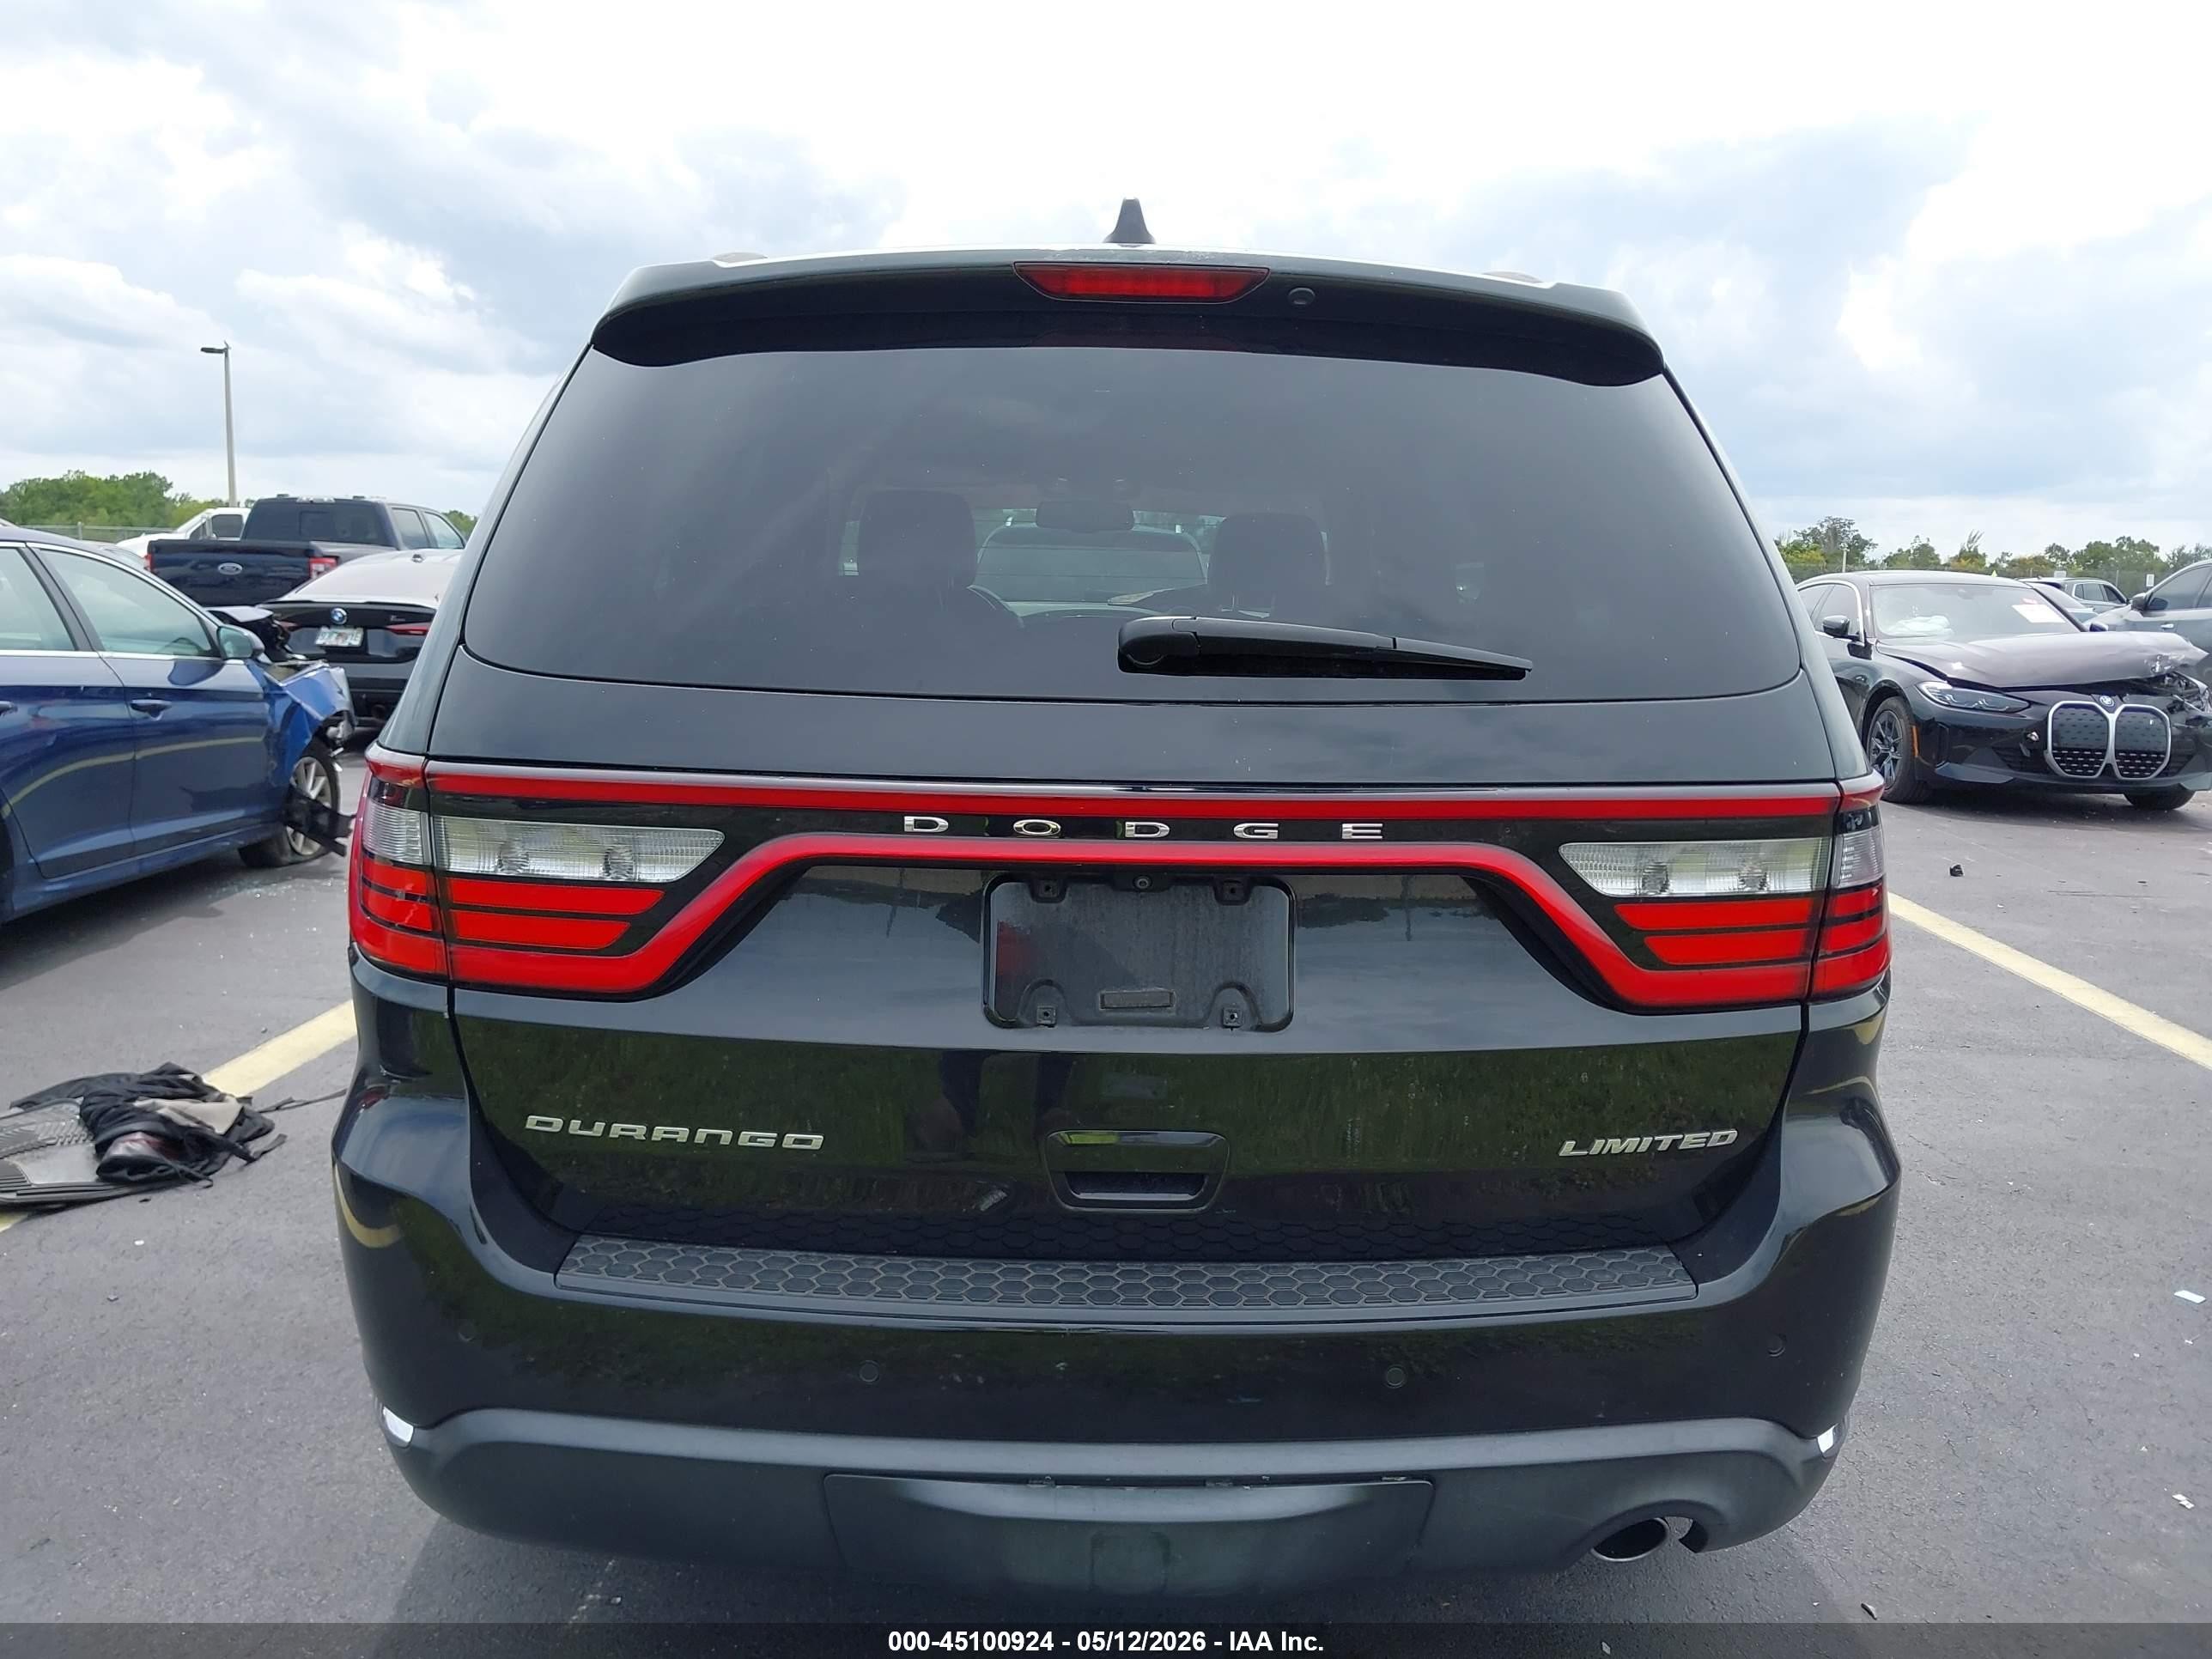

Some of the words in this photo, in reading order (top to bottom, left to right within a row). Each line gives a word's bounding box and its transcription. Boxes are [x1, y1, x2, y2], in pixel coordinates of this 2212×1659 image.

[903, 816, 1384, 840] DODGE
[525, 1115, 824, 1150] DURANGO
[1559, 1129, 1739, 1157] LIMITED
